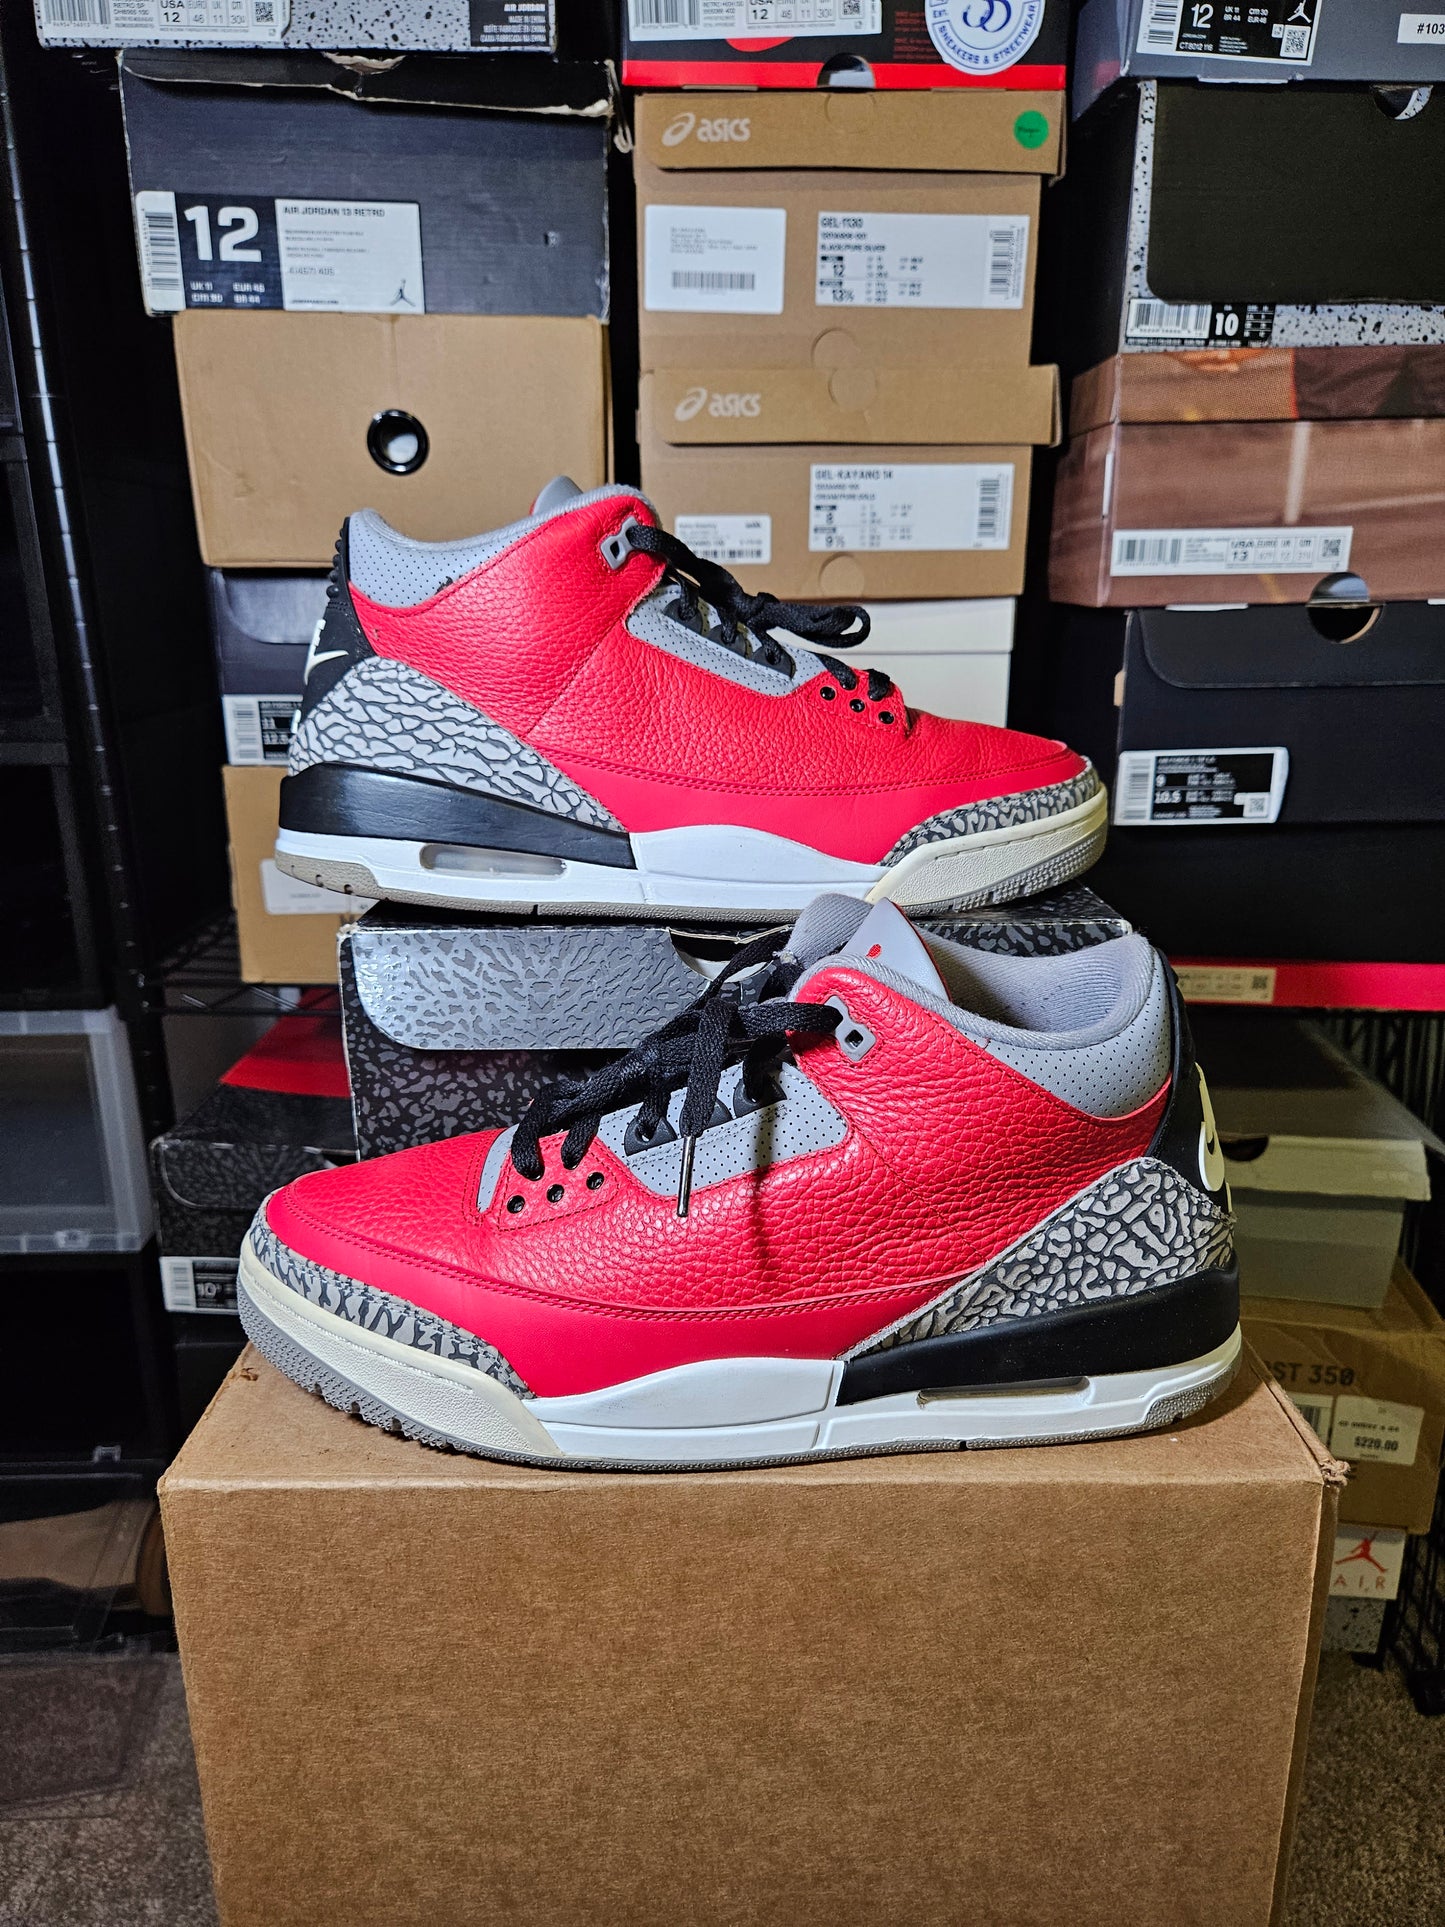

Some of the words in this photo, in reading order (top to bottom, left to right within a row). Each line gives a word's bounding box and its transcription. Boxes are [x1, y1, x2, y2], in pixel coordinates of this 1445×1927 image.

[160, 0, 185, 9] USA
[504, 4, 517, 12] AIR
[518, 4, 546, 12] JORDAN
[163, 12, 181, 22] 12
[193, 14, 205, 23] 46
[752, 9, 769, 20] 12
[801, 9, 811, 18] 11
[1191, 3, 1214, 29] 12
[938, 25, 980, 64] SNEAKERS
[982, 55, 990, 64] &
[994, 4, 1037, 62] STREETWEAR
[696, 117, 751, 143] asics
[284, 206, 299, 215] AIR
[301, 207, 340, 216] JORDAN
[353, 208, 385, 217] RETRO
[184, 205, 262, 262] 12
[833, 264, 845, 278] 12
[190, 281, 205, 291] UK
[232, 282, 252, 292] EUR
[1215, 312, 1239, 337] 10
[708, 392, 762, 418] asics
[1308, 1364, 1356, 1386] 350
[1333, 1573, 1386, 1590] AIR
